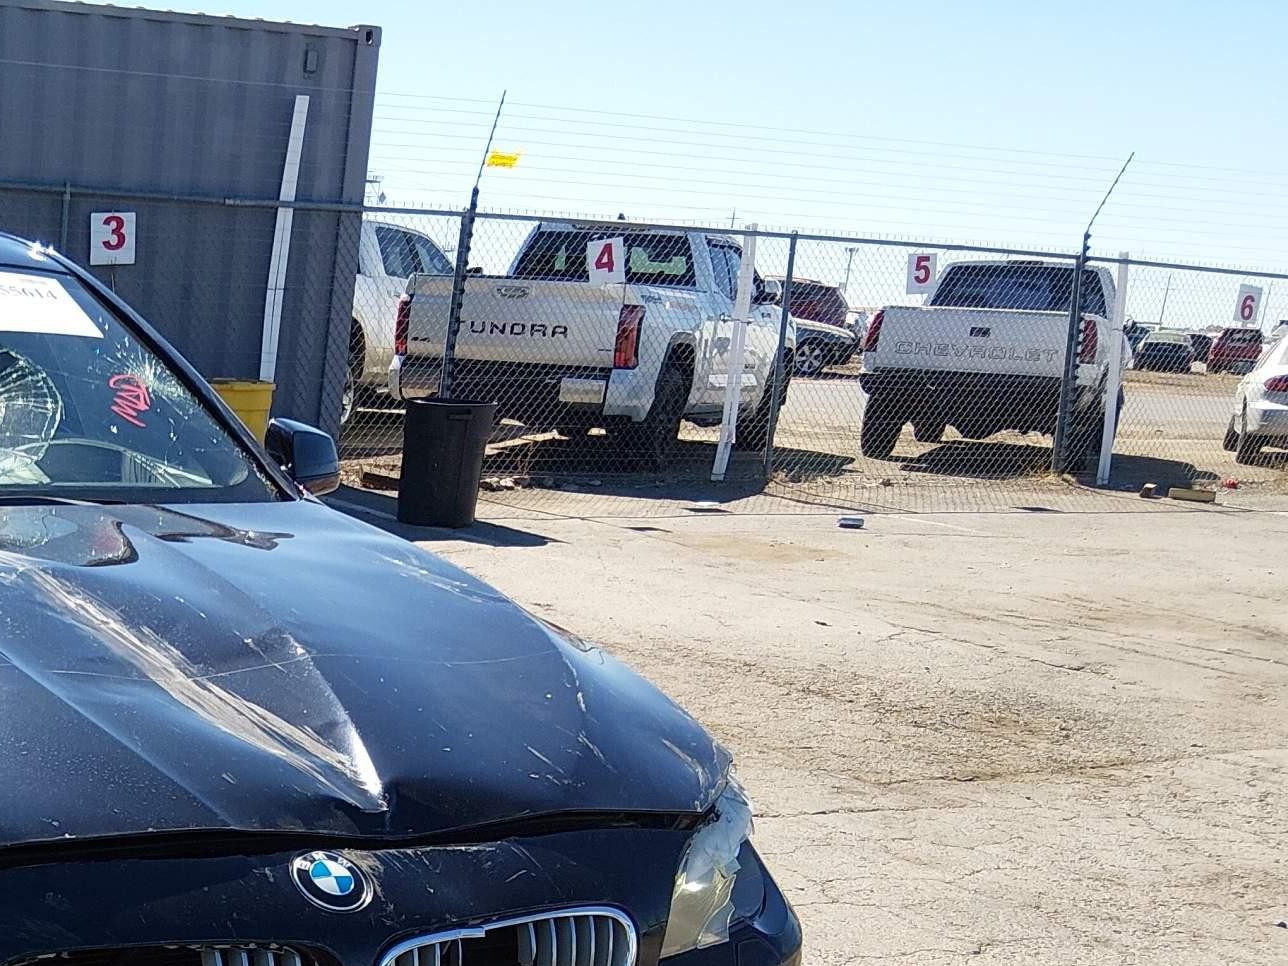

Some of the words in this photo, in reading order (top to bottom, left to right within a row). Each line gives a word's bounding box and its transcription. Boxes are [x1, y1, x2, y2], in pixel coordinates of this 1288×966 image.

[102, 215, 126, 251] 3
[595, 243, 615, 273] 4
[914, 255, 931, 284] 5
[1240, 294, 1255, 320] 6
[458, 319, 569, 340] UNDRA
[894, 341, 1059, 362] CHEVROLET
